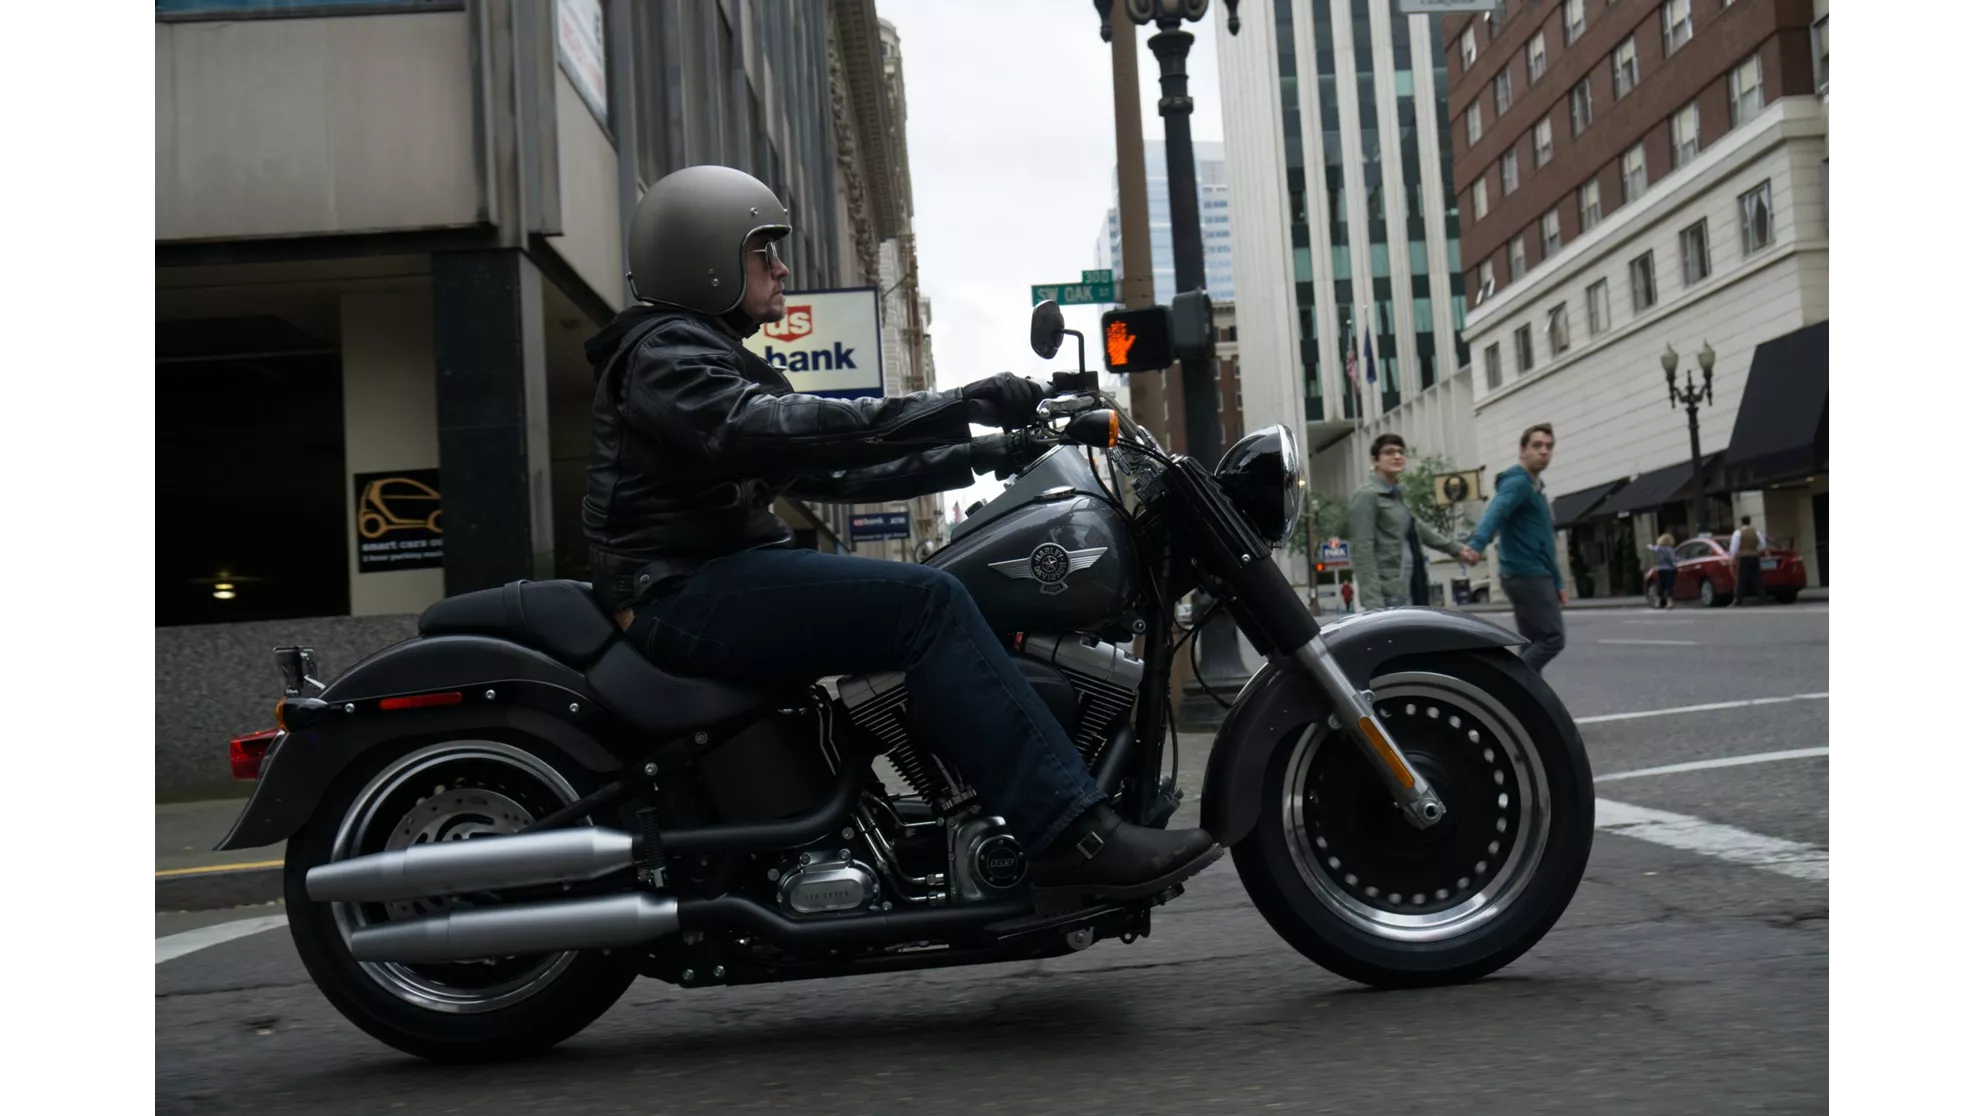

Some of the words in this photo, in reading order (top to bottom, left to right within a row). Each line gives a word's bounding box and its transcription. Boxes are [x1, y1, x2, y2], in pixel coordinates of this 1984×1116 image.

[1085, 270, 1109, 284] 300
[1064, 285, 1094, 302] OAK
[765, 342, 857, 372] bank
[361, 540, 398, 552] smart
[399, 540, 428, 549] cars
